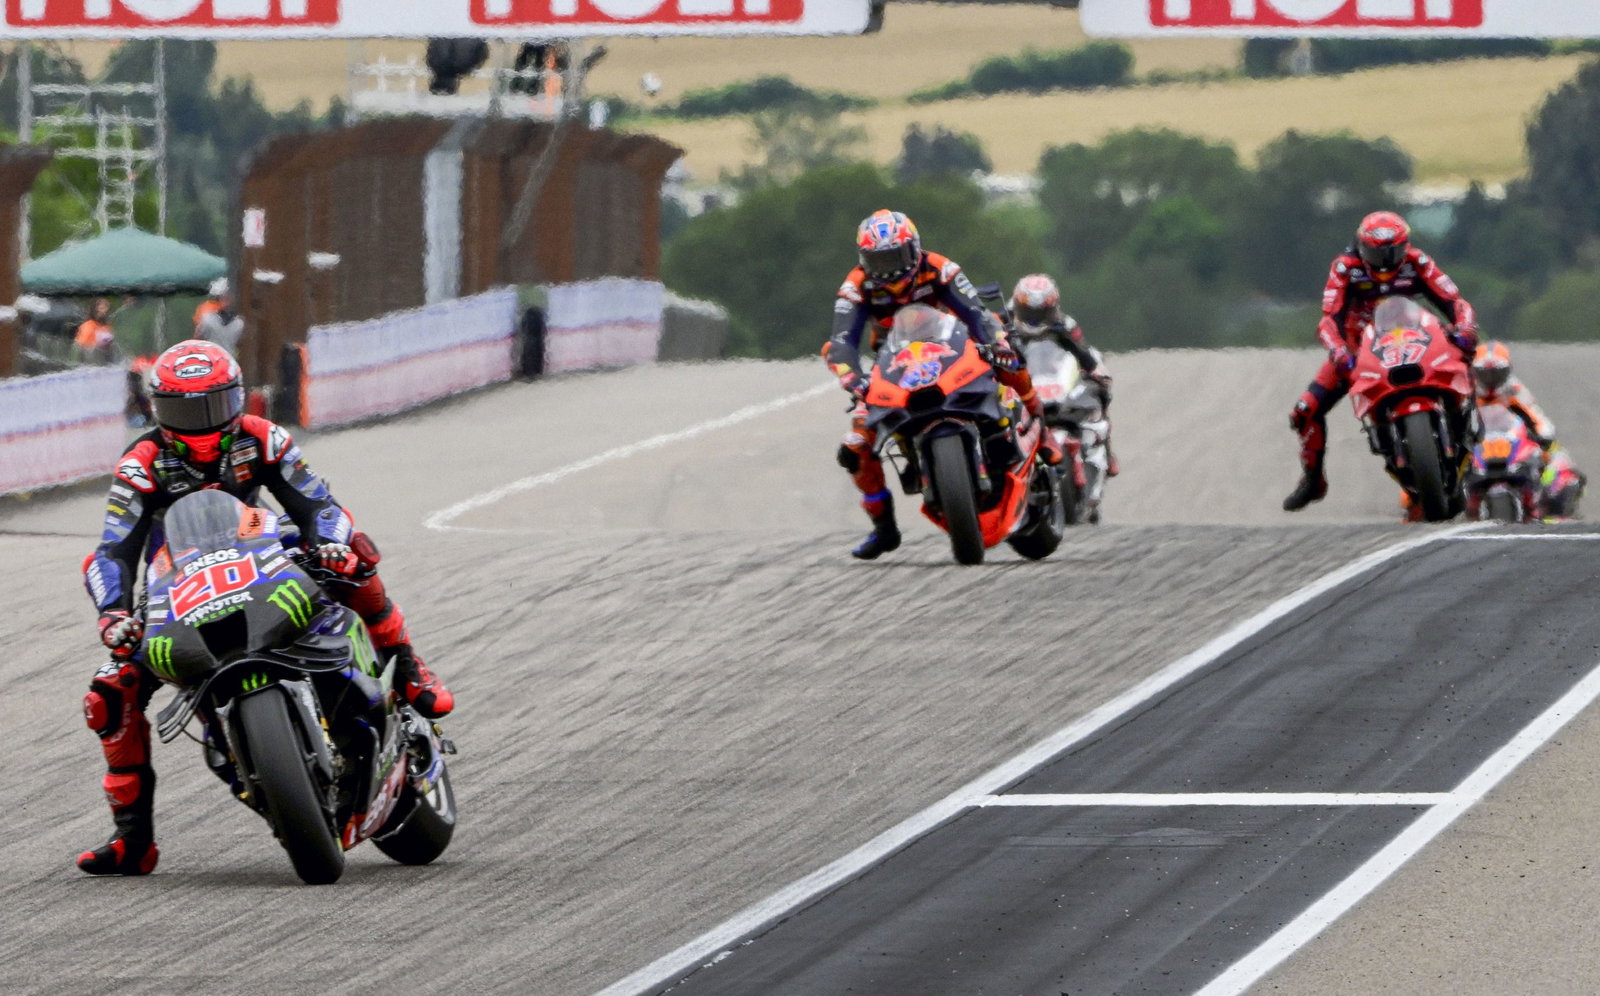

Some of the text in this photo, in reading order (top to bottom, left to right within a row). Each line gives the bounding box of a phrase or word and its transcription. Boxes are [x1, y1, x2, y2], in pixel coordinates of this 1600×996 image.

[1380, 342, 1427, 369] 37
[183, 548, 241, 576] ENEOS
[169, 552, 259, 621] 20
[184, 591, 254, 626] MONSTER
[193, 604, 245, 628] ENERGY
